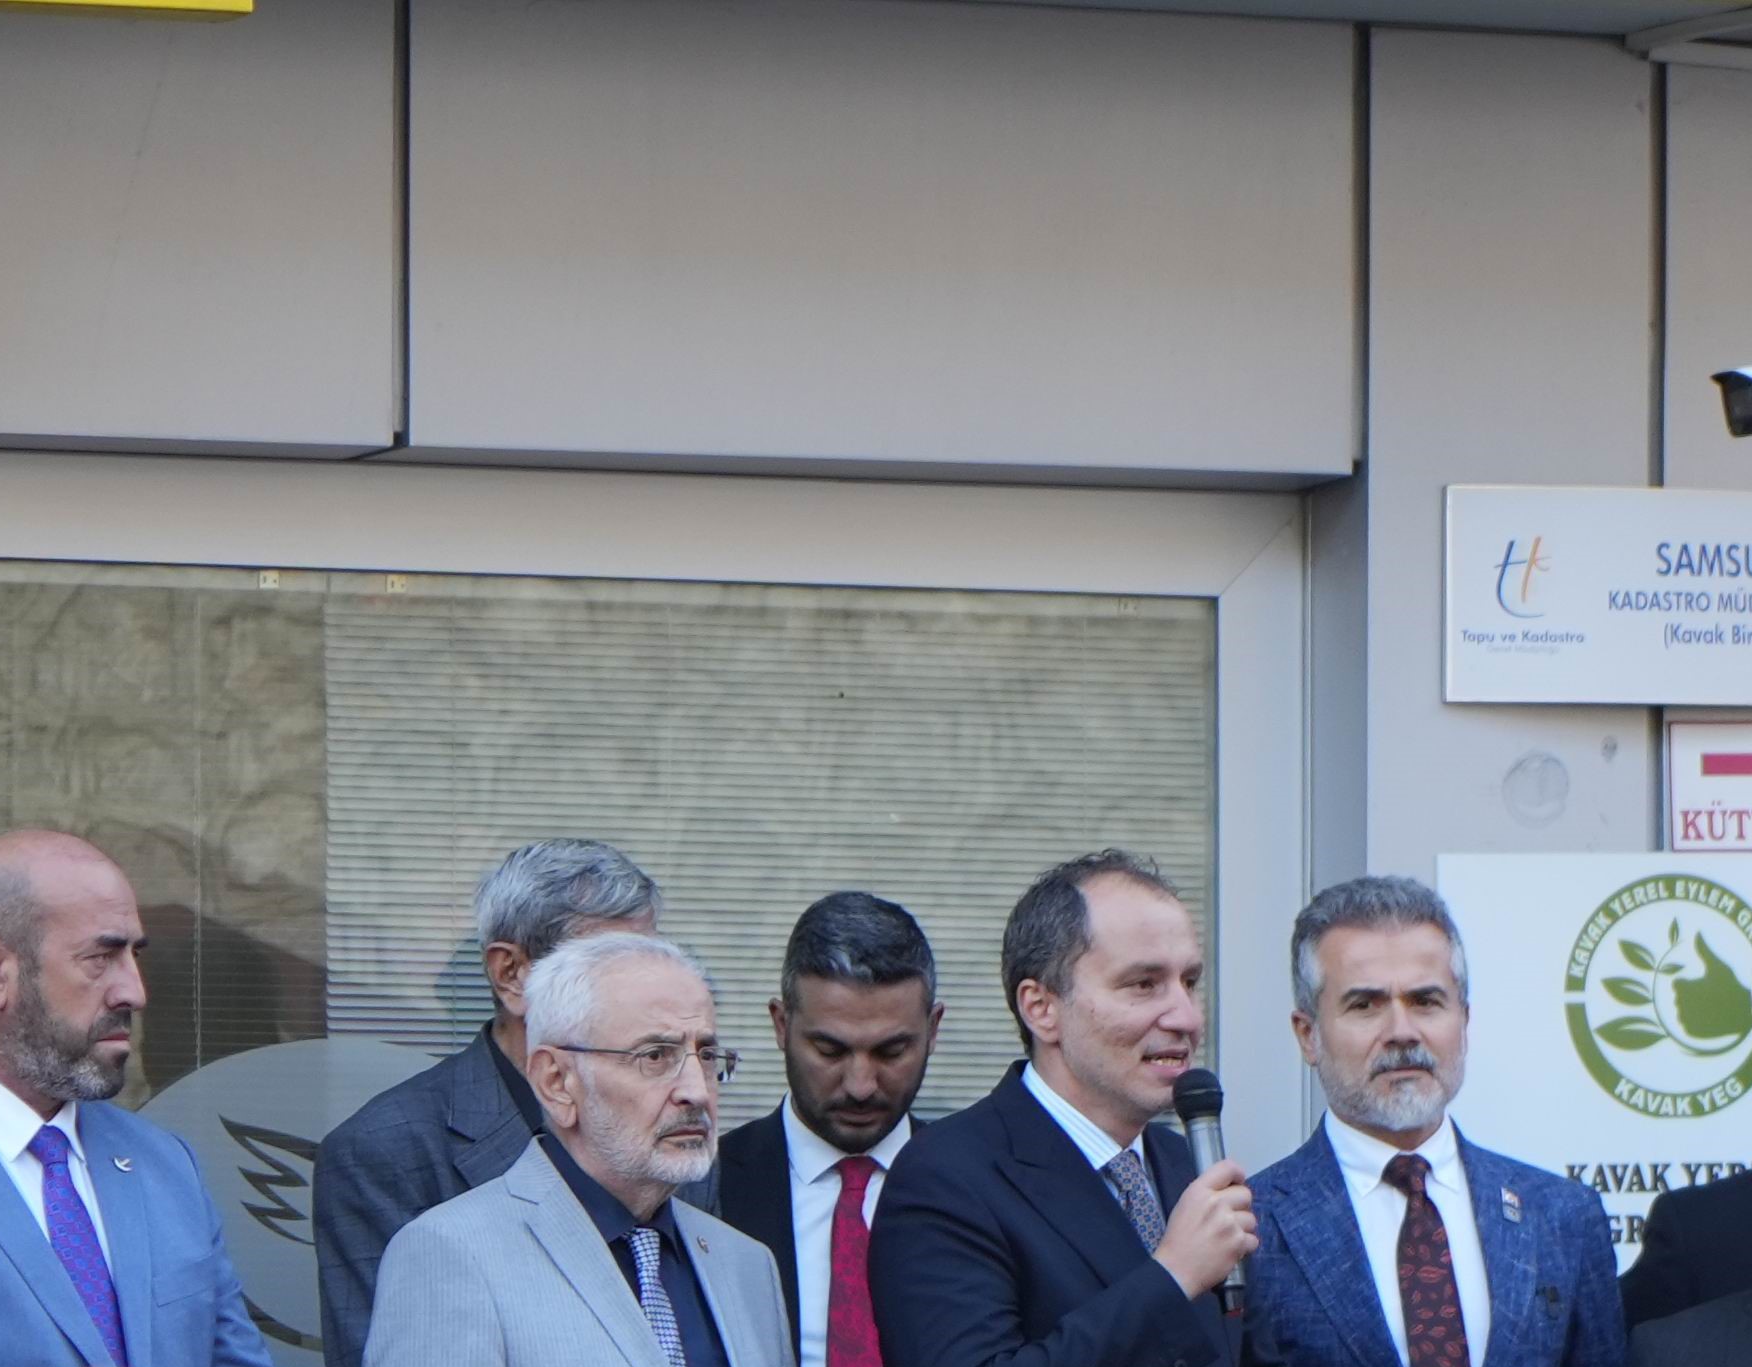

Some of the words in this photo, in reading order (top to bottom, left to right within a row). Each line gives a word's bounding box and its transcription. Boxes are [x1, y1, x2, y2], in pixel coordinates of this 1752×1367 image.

[1608, 590, 1710, 612] KADASTRO
[1461, 630, 1494, 646] Tapu
[1501, 633, 1517, 643] ve
[1664, 624, 1724, 649] (Kavak
[1569, 911, 1612, 978] KAVAK
[1609, 880, 1670, 916] YEREL
[1674, 879, 1736, 914] EYLEM
[1614, 1078, 1692, 1117] KAVAK
[1698, 1077, 1744, 1113] YEG
